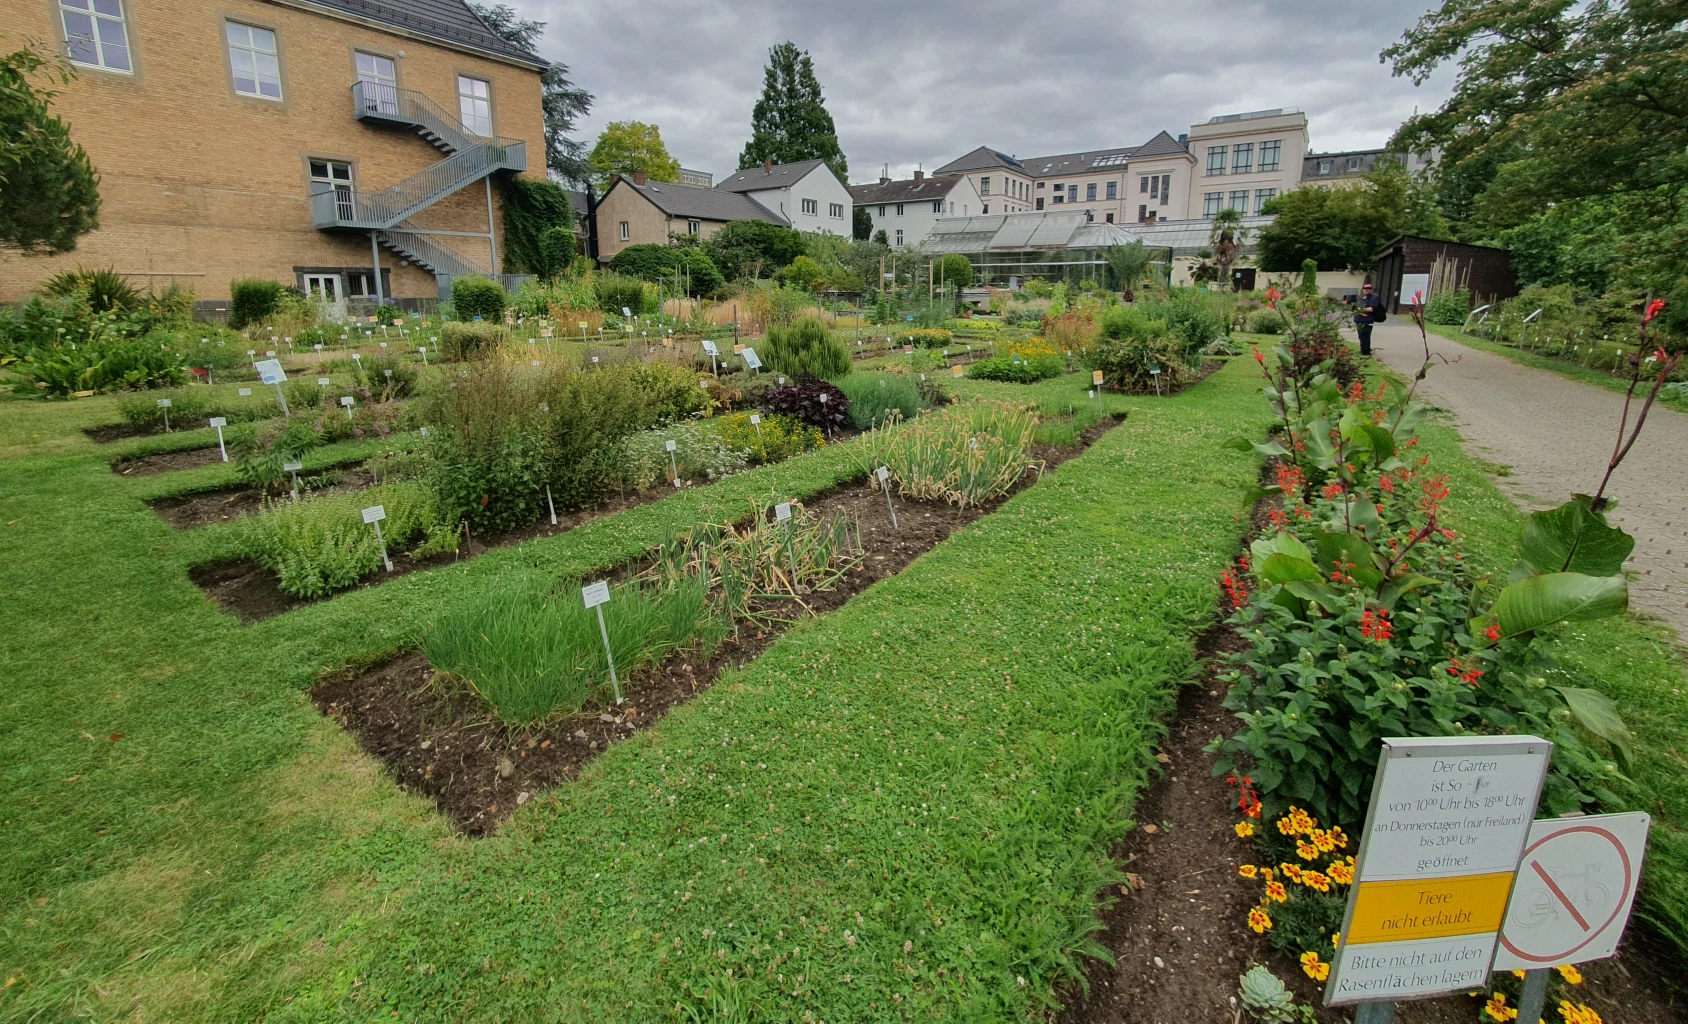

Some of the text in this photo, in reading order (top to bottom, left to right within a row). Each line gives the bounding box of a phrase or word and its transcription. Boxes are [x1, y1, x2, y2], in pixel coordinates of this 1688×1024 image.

[1433, 760, 1497, 772] Der Garten
[1432, 780, 1444, 792] ist
[1448, 780, 1462, 791] So
[1389, 803, 1411, 812] von
[1440, 797, 1461, 810] Uhr
[1464, 797, 1480, 809] bis
[1506, 794, 1526, 806] Uhr
[1375, 814, 1525, 833] an Donnerstagen (nur Freiland)
[1420, 836, 1433, 846] bis
[1459, 833, 1478, 845] Uhr
[1417, 855, 1468, 872] geöffnet
[1418, 891, 1453, 905] Tiere
[1382, 909, 1473, 930] nicht erlaubt
[1351, 945, 1482, 970] Bitte nicht auf den
[1338, 970, 1483, 992] Rasenflächen lagern
